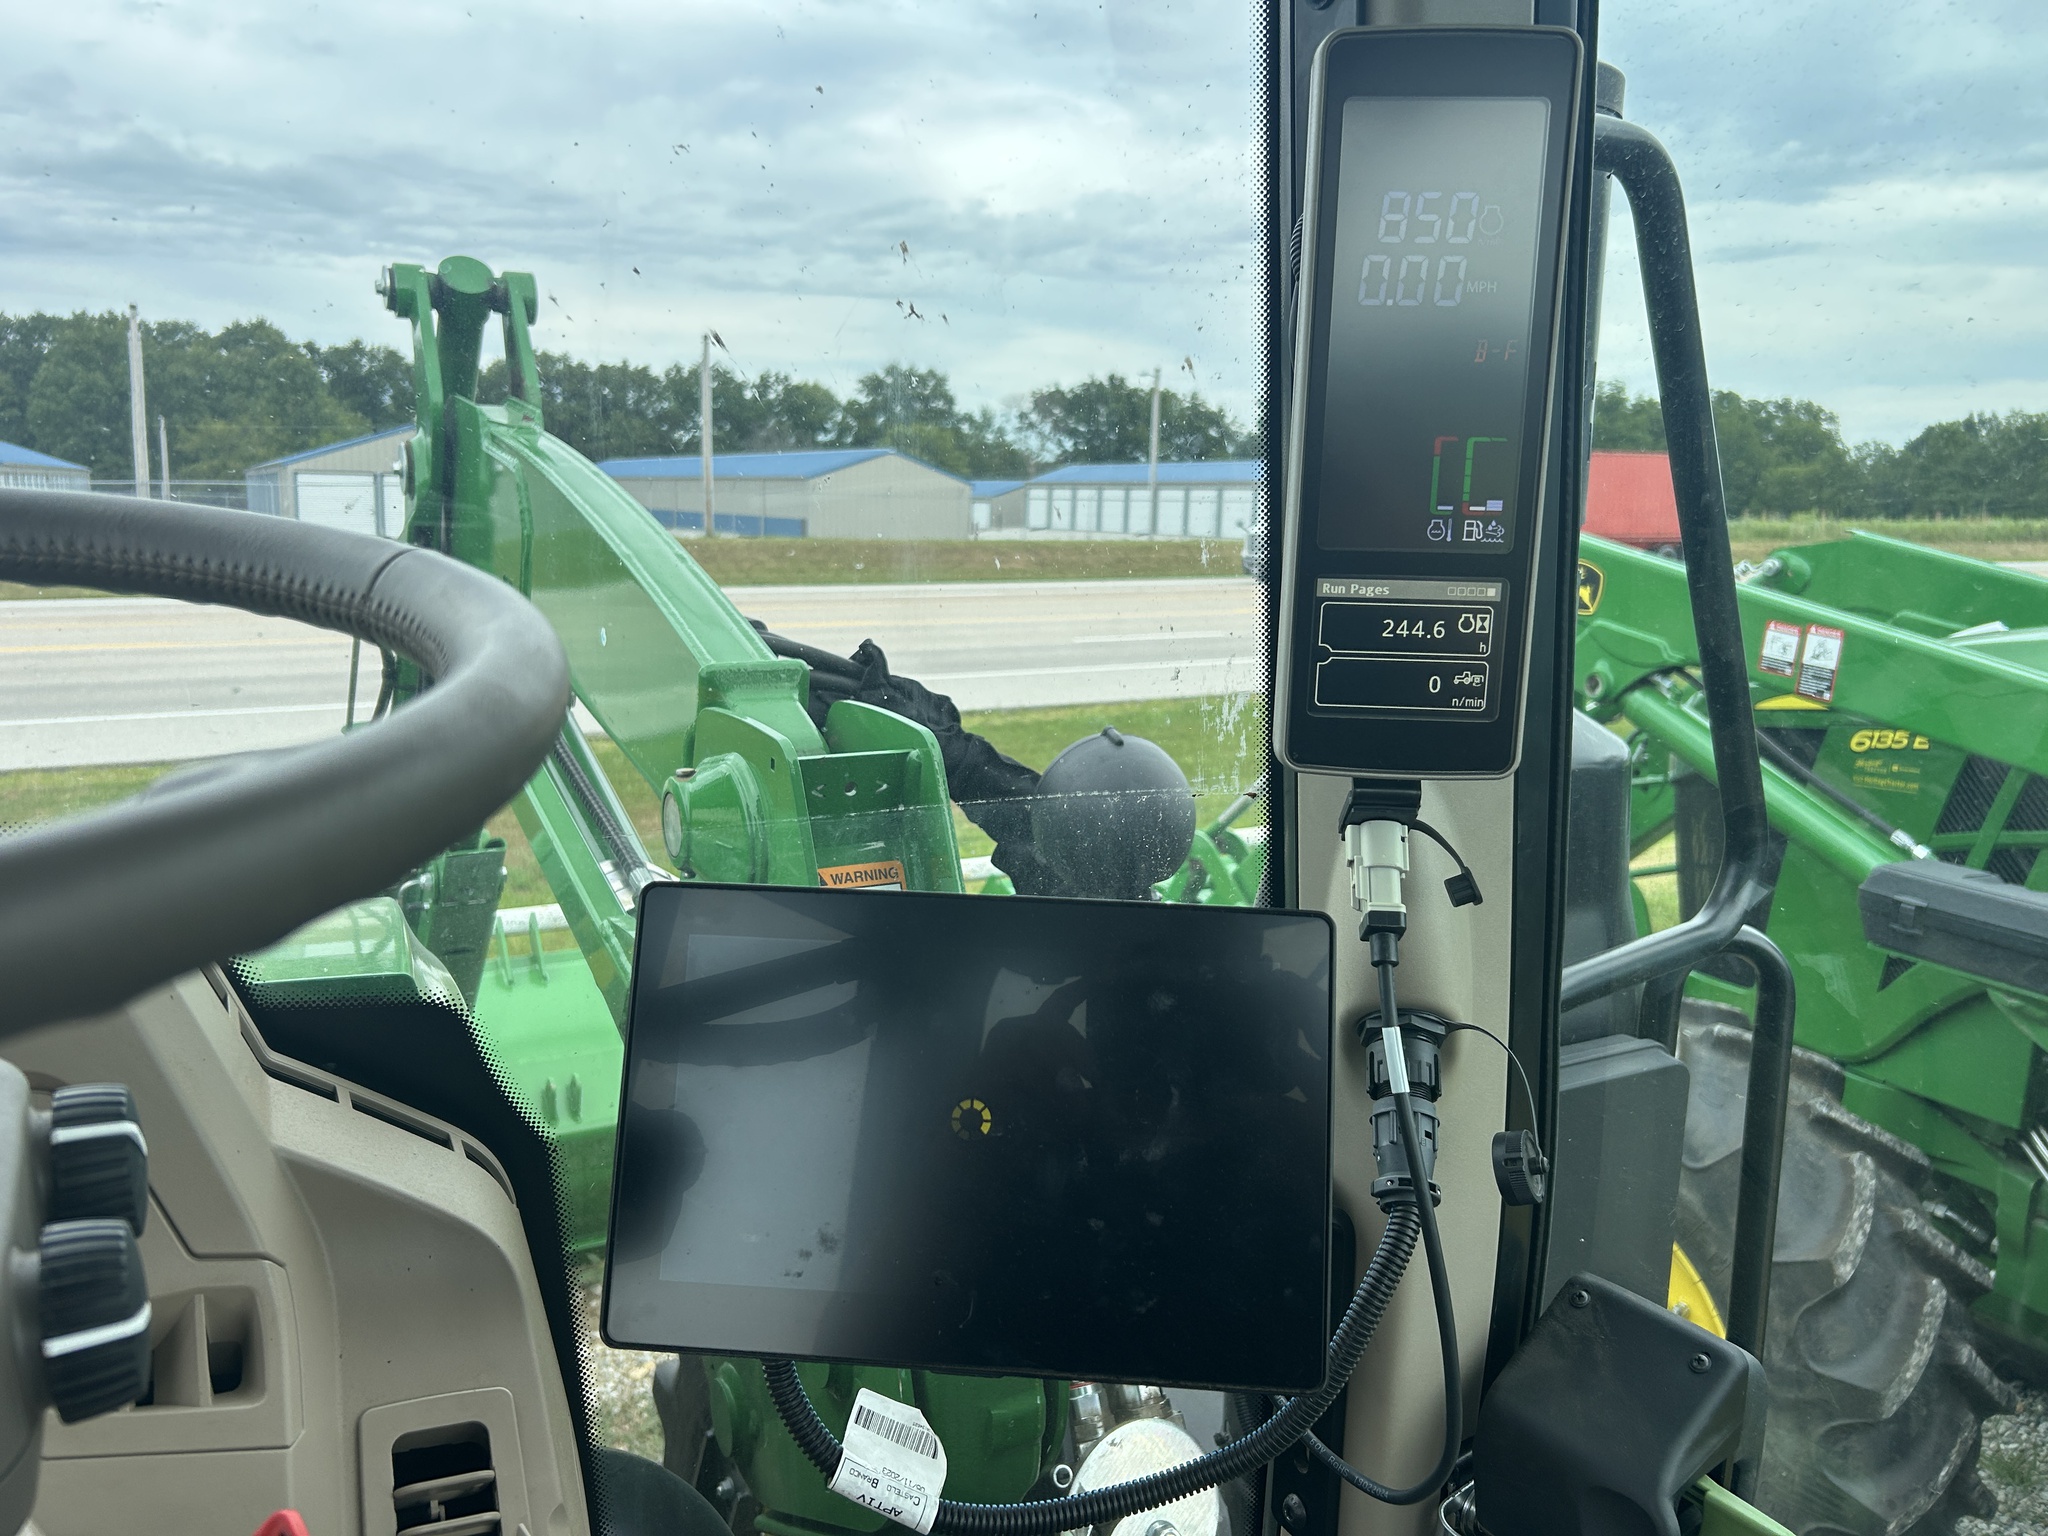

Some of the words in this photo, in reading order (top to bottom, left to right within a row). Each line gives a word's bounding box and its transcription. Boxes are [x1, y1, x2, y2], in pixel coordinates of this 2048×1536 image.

[1378, 191, 1479, 243] 850
[1358, 254, 1467, 306] 0.00
[1466, 281, 1497, 293] MPH
[1322, 583, 1346, 595] Run
[1350, 584, 1390, 597] Pages
[1381, 619, 1446, 639] 244.6
[1479, 642, 1487, 653] h
[1428, 675, 1442, 694] 0
[1451, 696, 1484, 708] n/min
[1850, 729, 1910, 753] 6135
[830, 867, 898, 885] WARNING
[1309, 1438, 1327, 1455] 60V
[1327, 1455, 1350, 1477] RoHS
[1353, 1475, 1389, 1498] 19022024
[856, 1493, 903, 1517] APTIV
